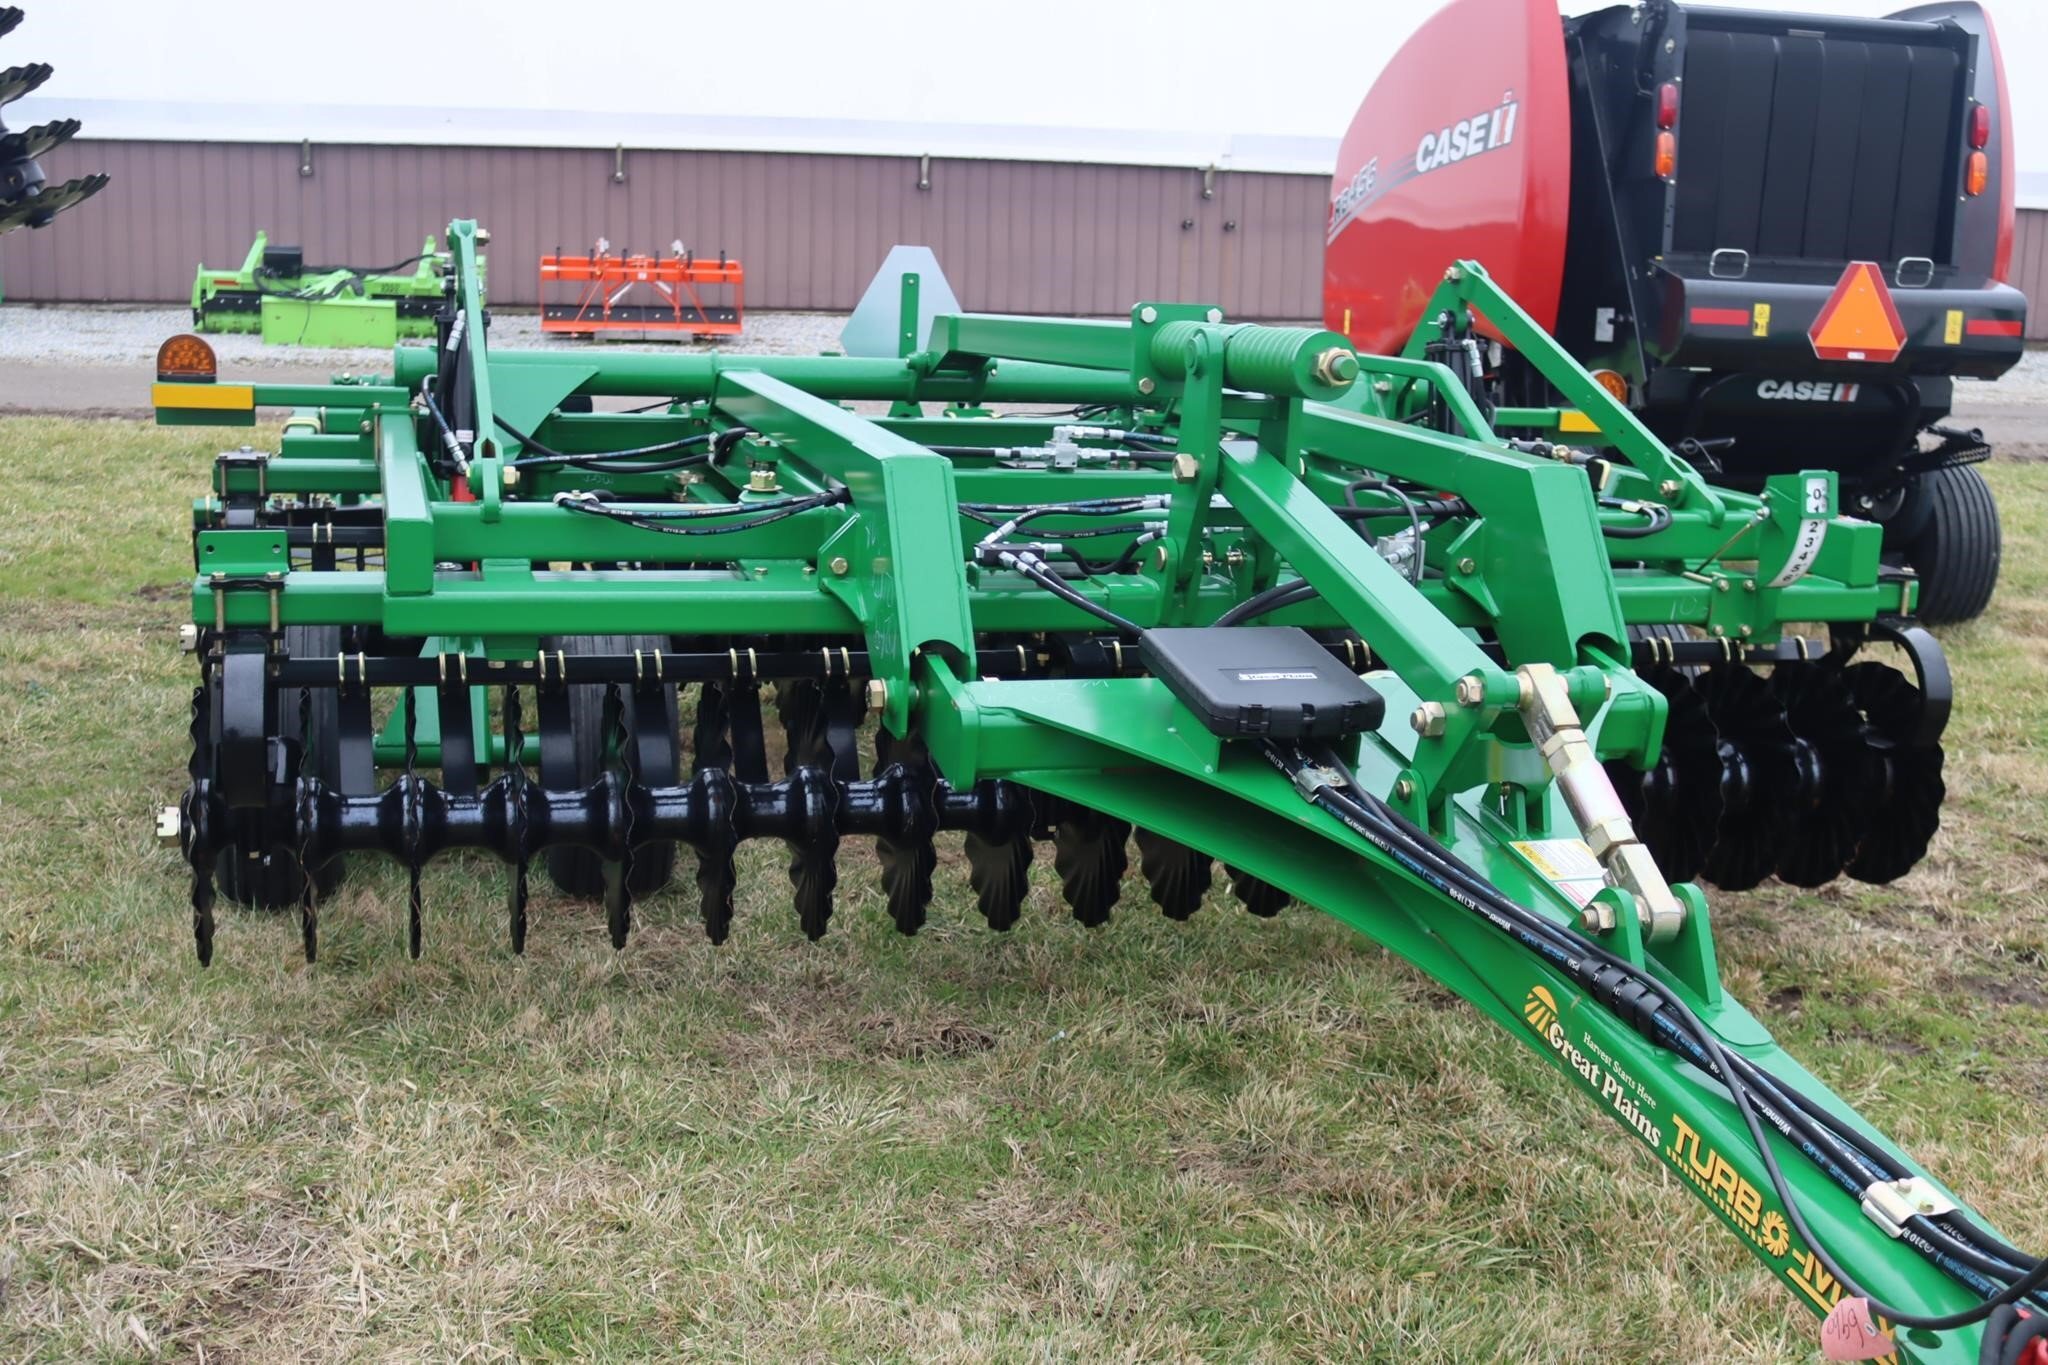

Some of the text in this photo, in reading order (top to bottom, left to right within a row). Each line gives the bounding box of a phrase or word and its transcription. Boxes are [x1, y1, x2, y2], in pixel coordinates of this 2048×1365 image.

[1415, 112, 1490, 173] CASE
[1757, 379, 1833, 402] CASE
[1813, 488, 1822, 500] 0
[1809, 521, 1819, 533] 2
[1804, 537, 1814, 548] 3
[1798, 551, 1809, 561] 4
[1791, 563, 1801, 573] 5
[1583, 1031, 1657, 1110] Harvest Starts Here
[1549, 1022, 1601, 1087] Great
[1601, 1071, 1662, 1148] Plains
[1761, 1105, 1792, 1136] Winner
